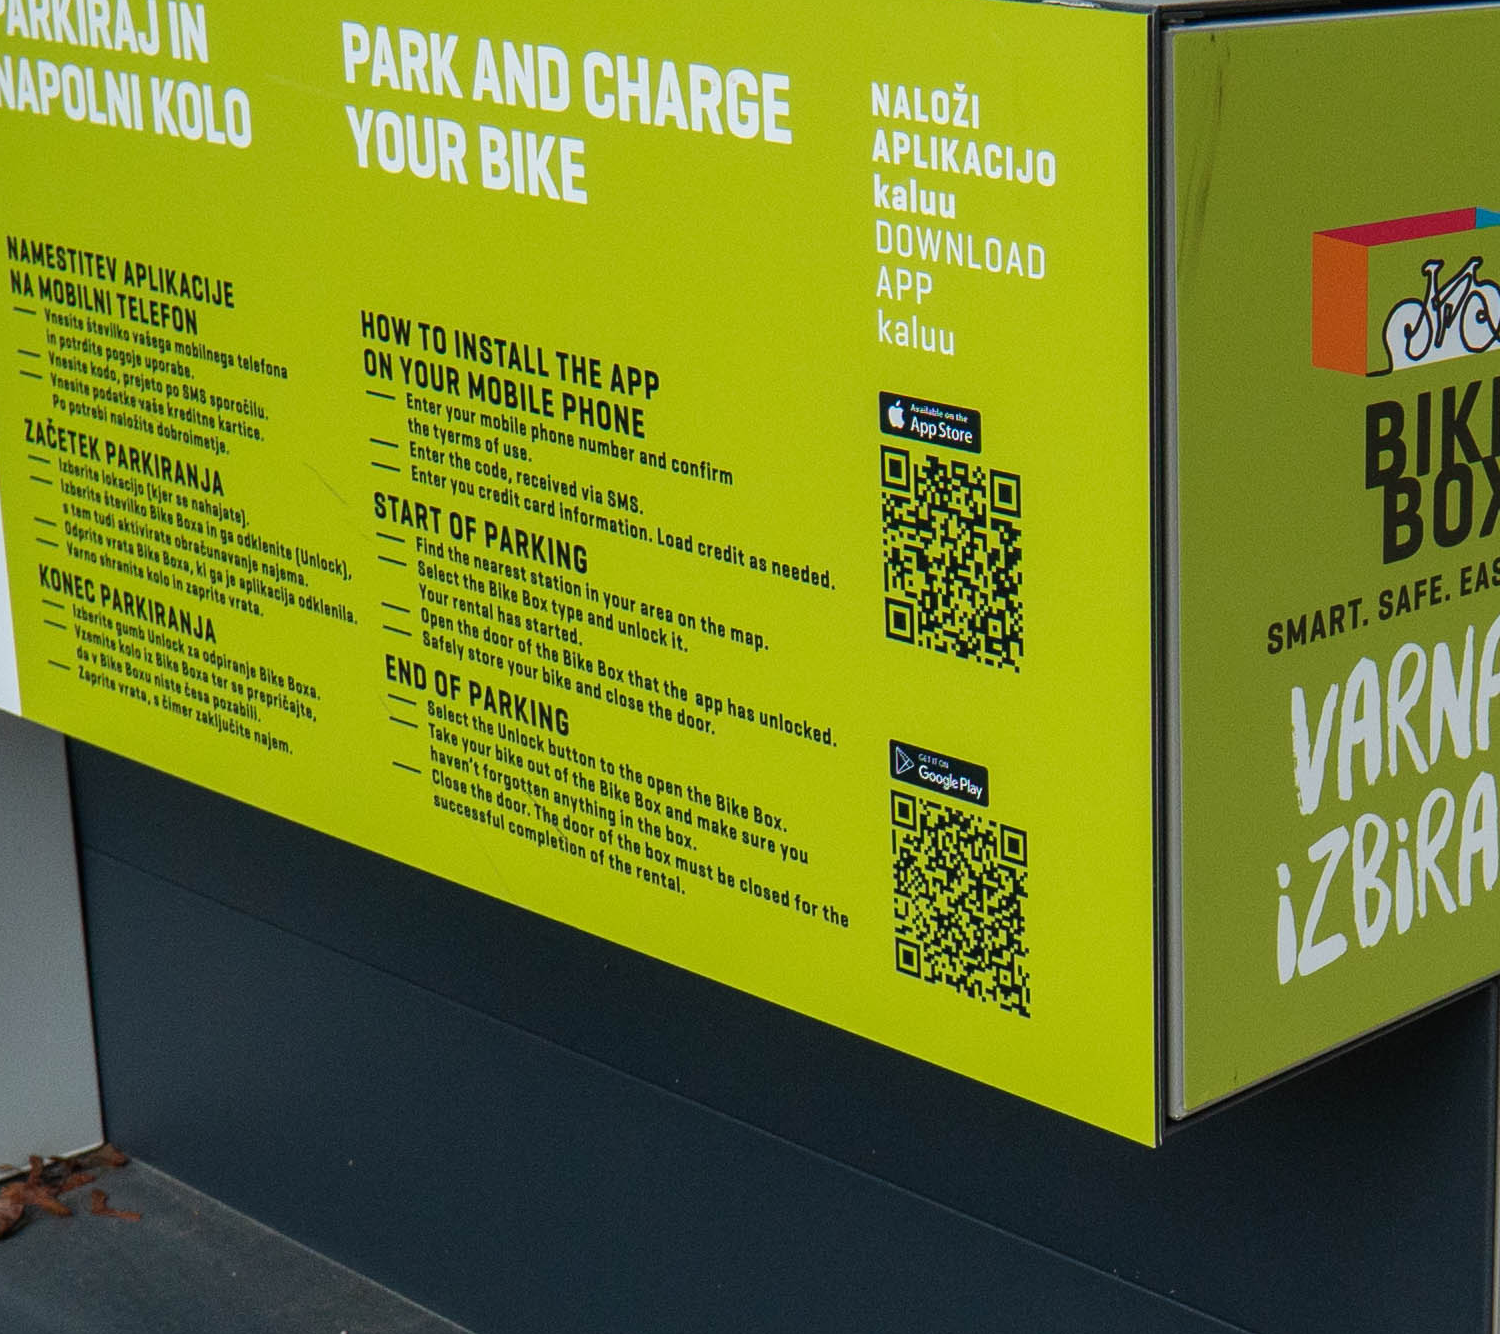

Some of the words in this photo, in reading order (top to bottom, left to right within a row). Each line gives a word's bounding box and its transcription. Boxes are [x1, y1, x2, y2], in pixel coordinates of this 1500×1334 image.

[168, 1, 209, 64] IN
[150, 77, 252, 149] KOLO
[342, 22, 464, 99] PARK
[472, 38, 570, 113] AND
[583, 51, 792, 145] CHARGE
[871, 82, 980, 130] NALOŽI
[345, 105, 469, 185] YOUR
[479, 125, 588, 205] BIKE
[872, 129, 1056, 187] APLIKACIJO
[874, 173, 956, 219] kaluu
[6, 235, 117, 283] NAMESTITEV
[124, 260, 235, 309] APLIKACIJE
[876, 219, 1045, 280] DOWNLOAD
[876, 265, 932, 305] APP
[10, 269, 34, 297] NA
[38, 275, 112, 316] MOBILNI
[116, 292, 198, 336] TELEFON
[878, 309, 954, 356] kaluu
[361, 310, 411, 347] HOW
[417, 322, 447, 355] TO
[454, 329, 550, 377] INSTALL
[555, 351, 602, 389] THE
[610, 363, 660, 400] APP
[363, 348, 393, 381] ON
[399, 356, 460, 397] YOUR
[467, 371, 555, 418] MOBILE
[562, 392, 645, 439] PHONE
[910, 415, 937, 440] App
[938, 422, 973, 444] Store
[24, 418, 101, 462] ZAČETEK
[105, 440, 224, 497] PARKIRANJA
[406, 392, 442, 416] Enter
[445, 405, 476, 424] your
[480, 413, 527, 437] mobile
[530, 422, 575, 448] phone
[578, 436, 635, 462] number
[639, 450, 667, 470] and
[671, 458, 733, 486] confirm
[407, 417, 430, 437] the
[485, 436, 499, 454] of
[503, 443, 532, 462] use.
[373, 491, 442, 535] START
[449, 511, 477, 543] OF
[484, 520, 588, 574] PARKING
[38, 563, 96, 604] KONEC
[100, 583, 217, 644] PARKIRANJA
[1267, 598, 1369, 655] SMART.
[1378, 574, 1451, 621] SAFE.
[385, 653, 427, 691] END
[434, 669, 461, 701] OF
[468, 680, 569, 737] PARKING
[482, 763, 549, 801] forgotten
[553, 791, 616, 827] anything
[619, 809, 634, 829] in
[637, 817, 662, 839] the
[665, 824, 697, 851] box.
[918, 764, 959, 791] Google
[959, 776, 983, 800] Play
